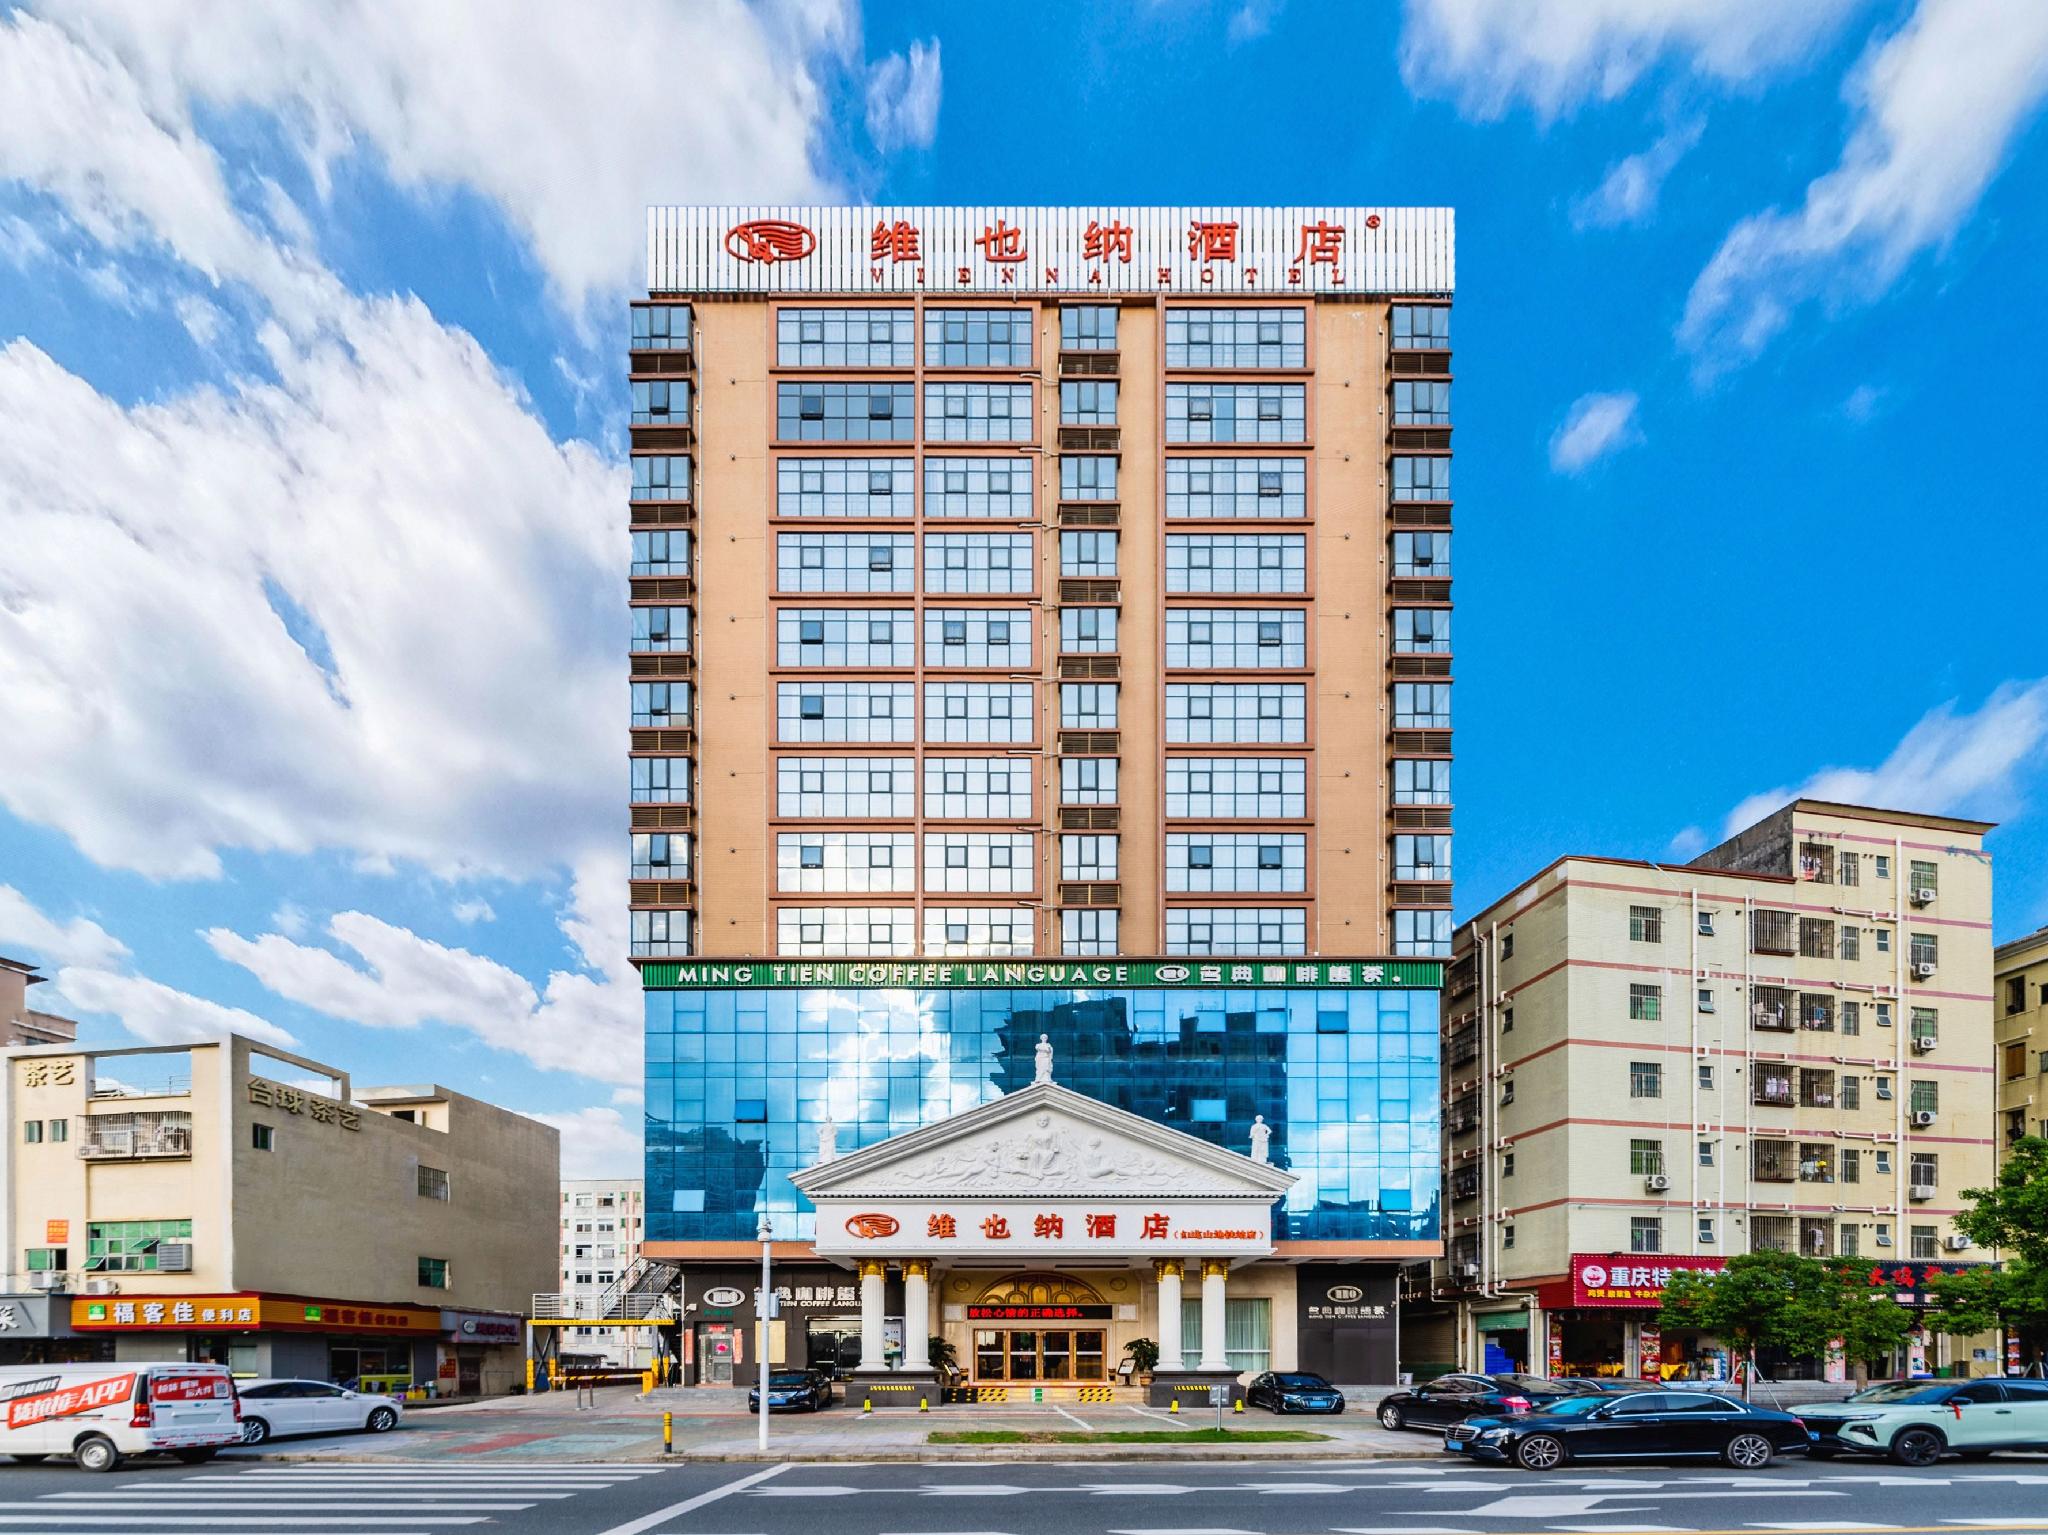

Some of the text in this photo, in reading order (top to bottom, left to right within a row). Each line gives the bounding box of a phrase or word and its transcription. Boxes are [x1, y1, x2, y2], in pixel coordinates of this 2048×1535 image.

[871, 219, 1345, 264] 维也纳酒店
[870, 267, 1345, 284] VIENNA HOTEL
[678, 966, 1128, 983] MING TIEN COFFEE LANGUAGE
[23, 1060, 75, 1088] 茶艺
[927, 1213, 1170, 1240] 维也纳酒店
